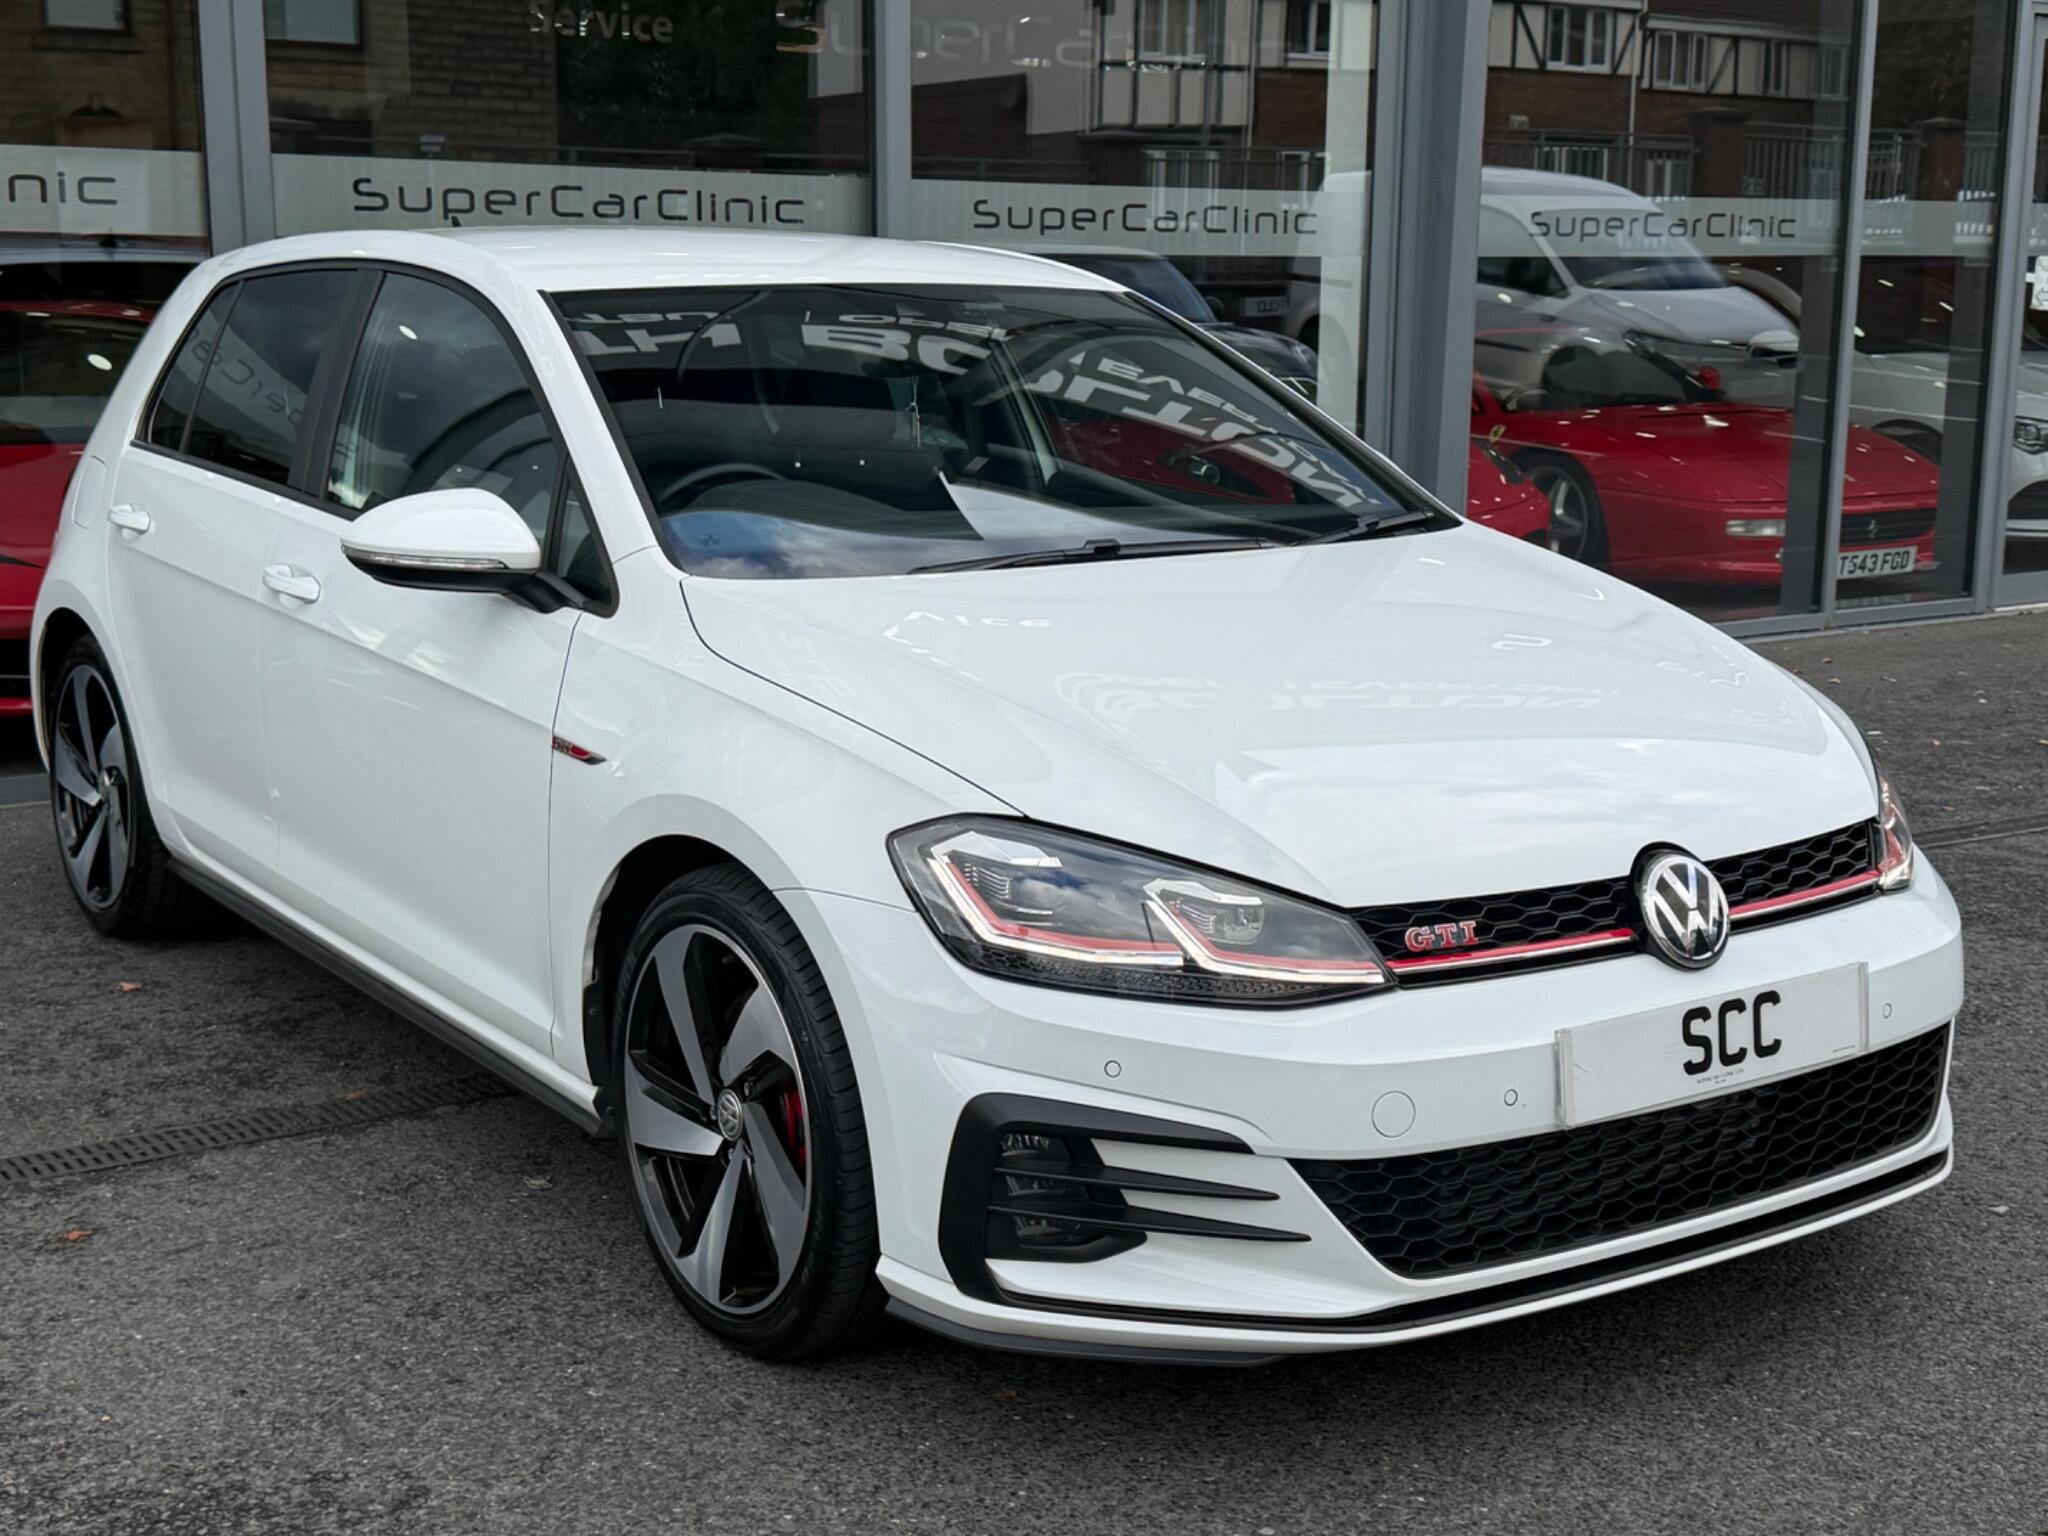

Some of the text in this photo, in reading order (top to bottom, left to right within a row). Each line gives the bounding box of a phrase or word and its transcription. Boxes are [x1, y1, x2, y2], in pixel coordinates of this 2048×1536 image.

[529, 0, 673, 43] Service
[353, 177, 804, 224] SuperCarClinic
[974, 199, 1317, 236] SuperCarClinic
[1530, 211, 1797, 242] SuperCarClinic
[1405, 920, 1480, 954] GTI
[1681, 990, 1783, 1076] SCC
